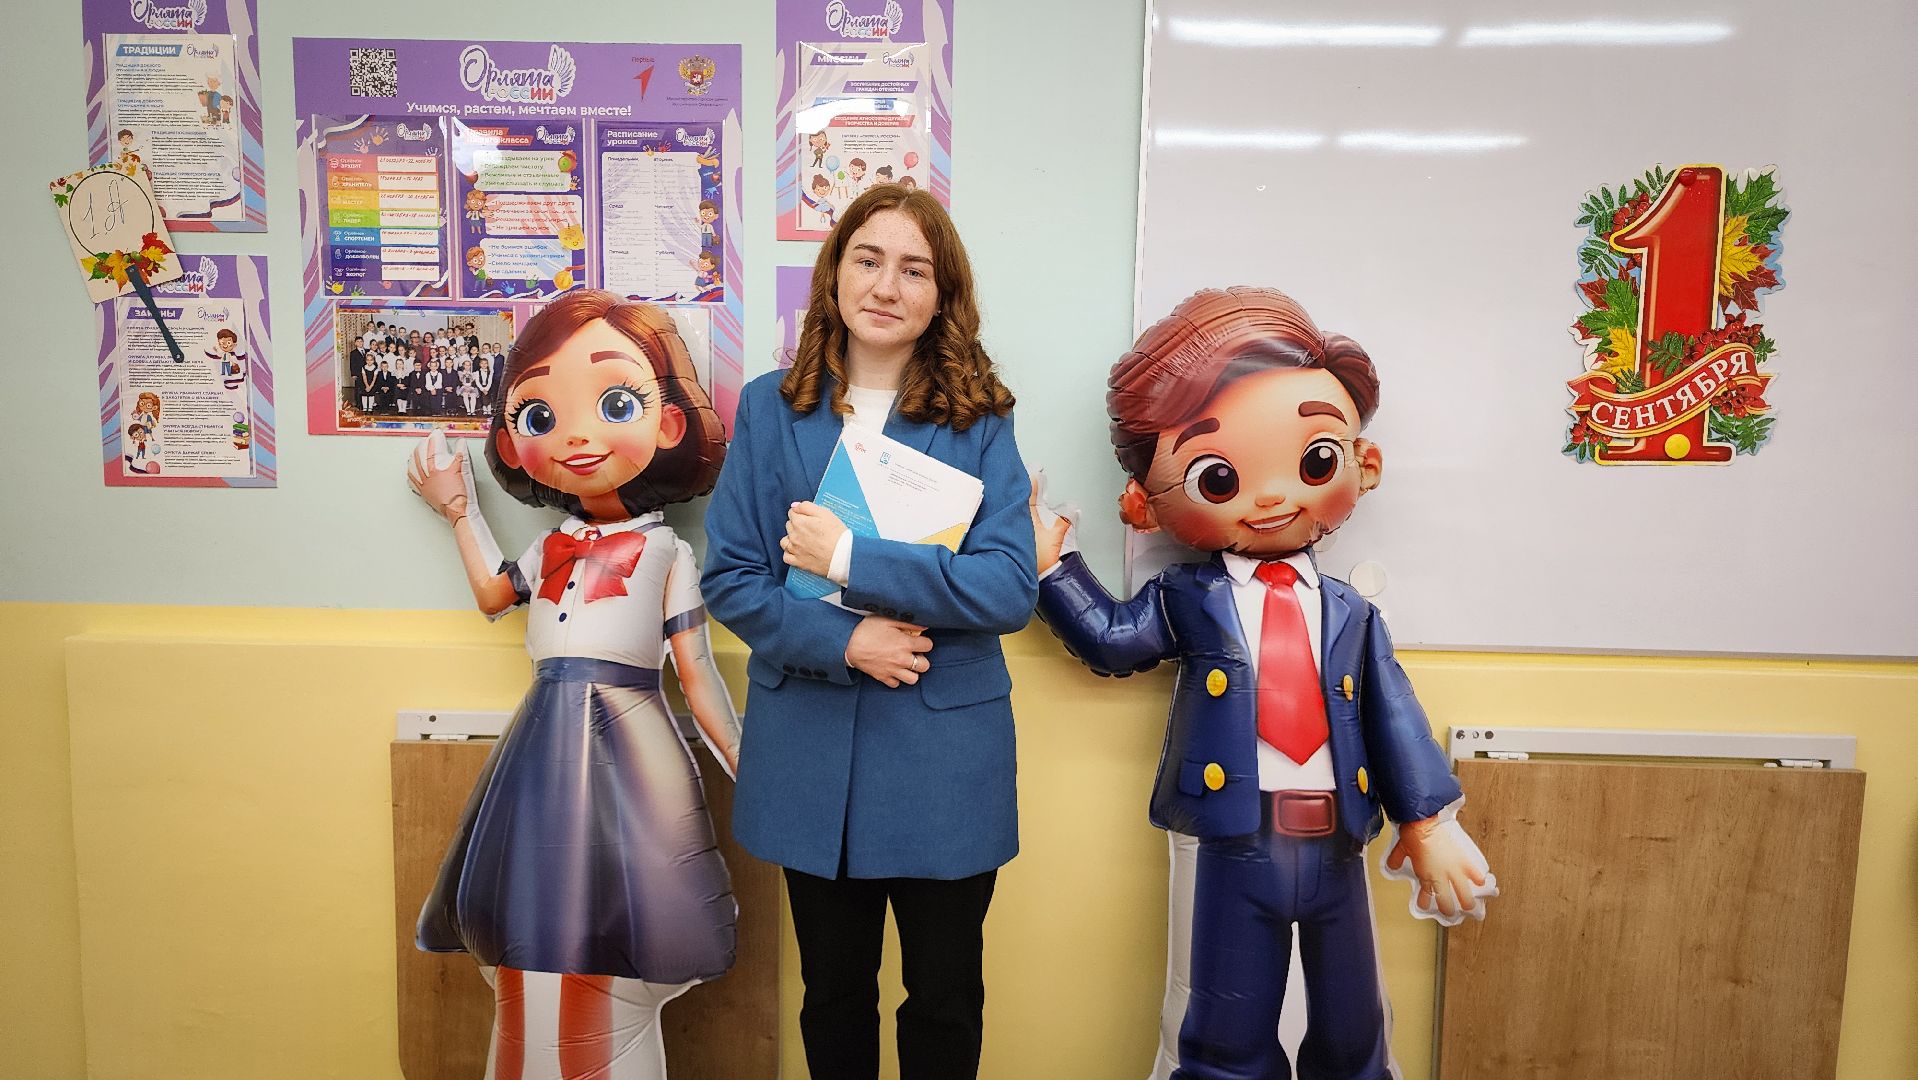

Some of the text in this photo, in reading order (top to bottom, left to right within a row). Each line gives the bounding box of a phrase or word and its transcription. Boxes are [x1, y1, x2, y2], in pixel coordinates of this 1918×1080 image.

[828, 1, 889, 30] Орлята
[123, 46, 176, 55] ТРАДИЦИИ
[463, 47, 554, 93] Орлята
[487, 86, 554, 101] РОССИИ
[406, 102, 632, 116] Учимся, растем, мечтаем вместе!
[607, 130, 659, 138] Расписание
[607, 139, 638, 147] уроков
[134, 310, 176, 318] ЗАКНЫ
[1594, 164, 1736, 465] 1
[1590, 351, 1752, 430] СЕНТЯБРЯ
